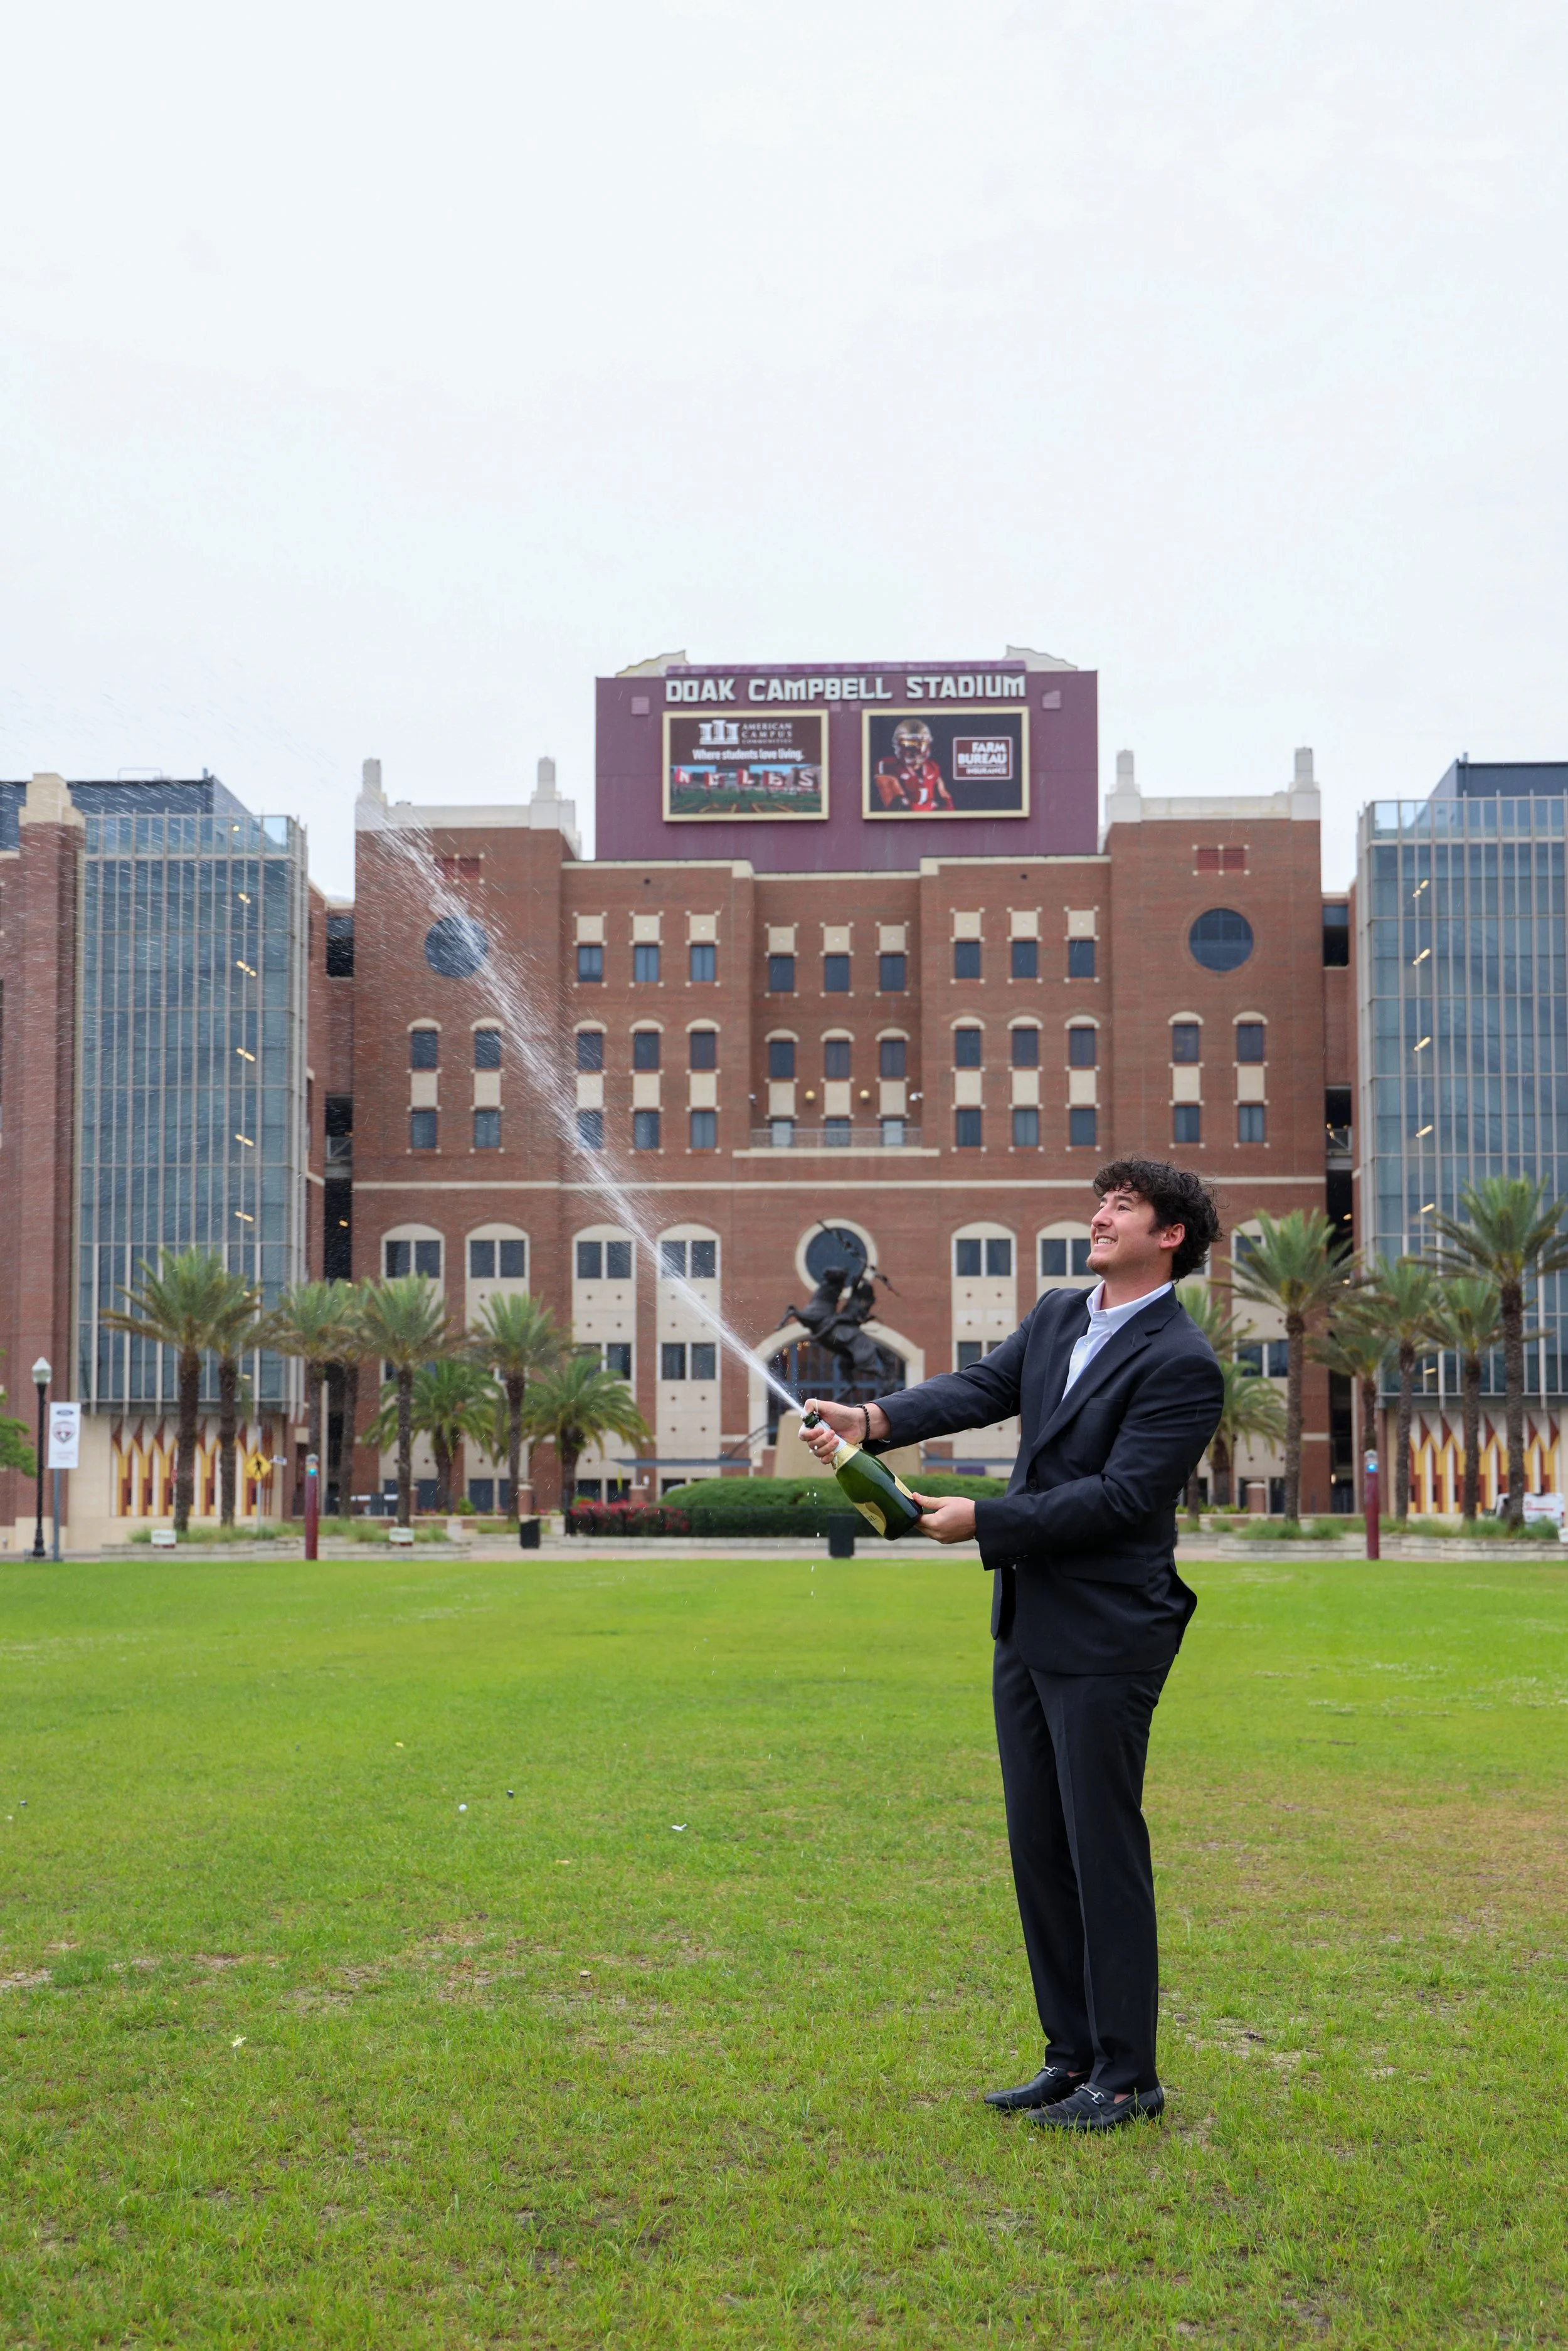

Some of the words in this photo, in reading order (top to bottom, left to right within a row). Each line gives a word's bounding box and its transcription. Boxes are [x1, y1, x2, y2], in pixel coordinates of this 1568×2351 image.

[665, 679, 736, 702] DOAK
[748, 677, 892, 701] CAMPBELL
[906, 675, 1025, 699] STADIUM
[972, 741, 1007, 753] FARM
[692, 749, 721, 760] Where
[722, 748, 758, 760] students
[759, 748, 777, 760] love
[958, 753, 1007, 764] BUREAU
